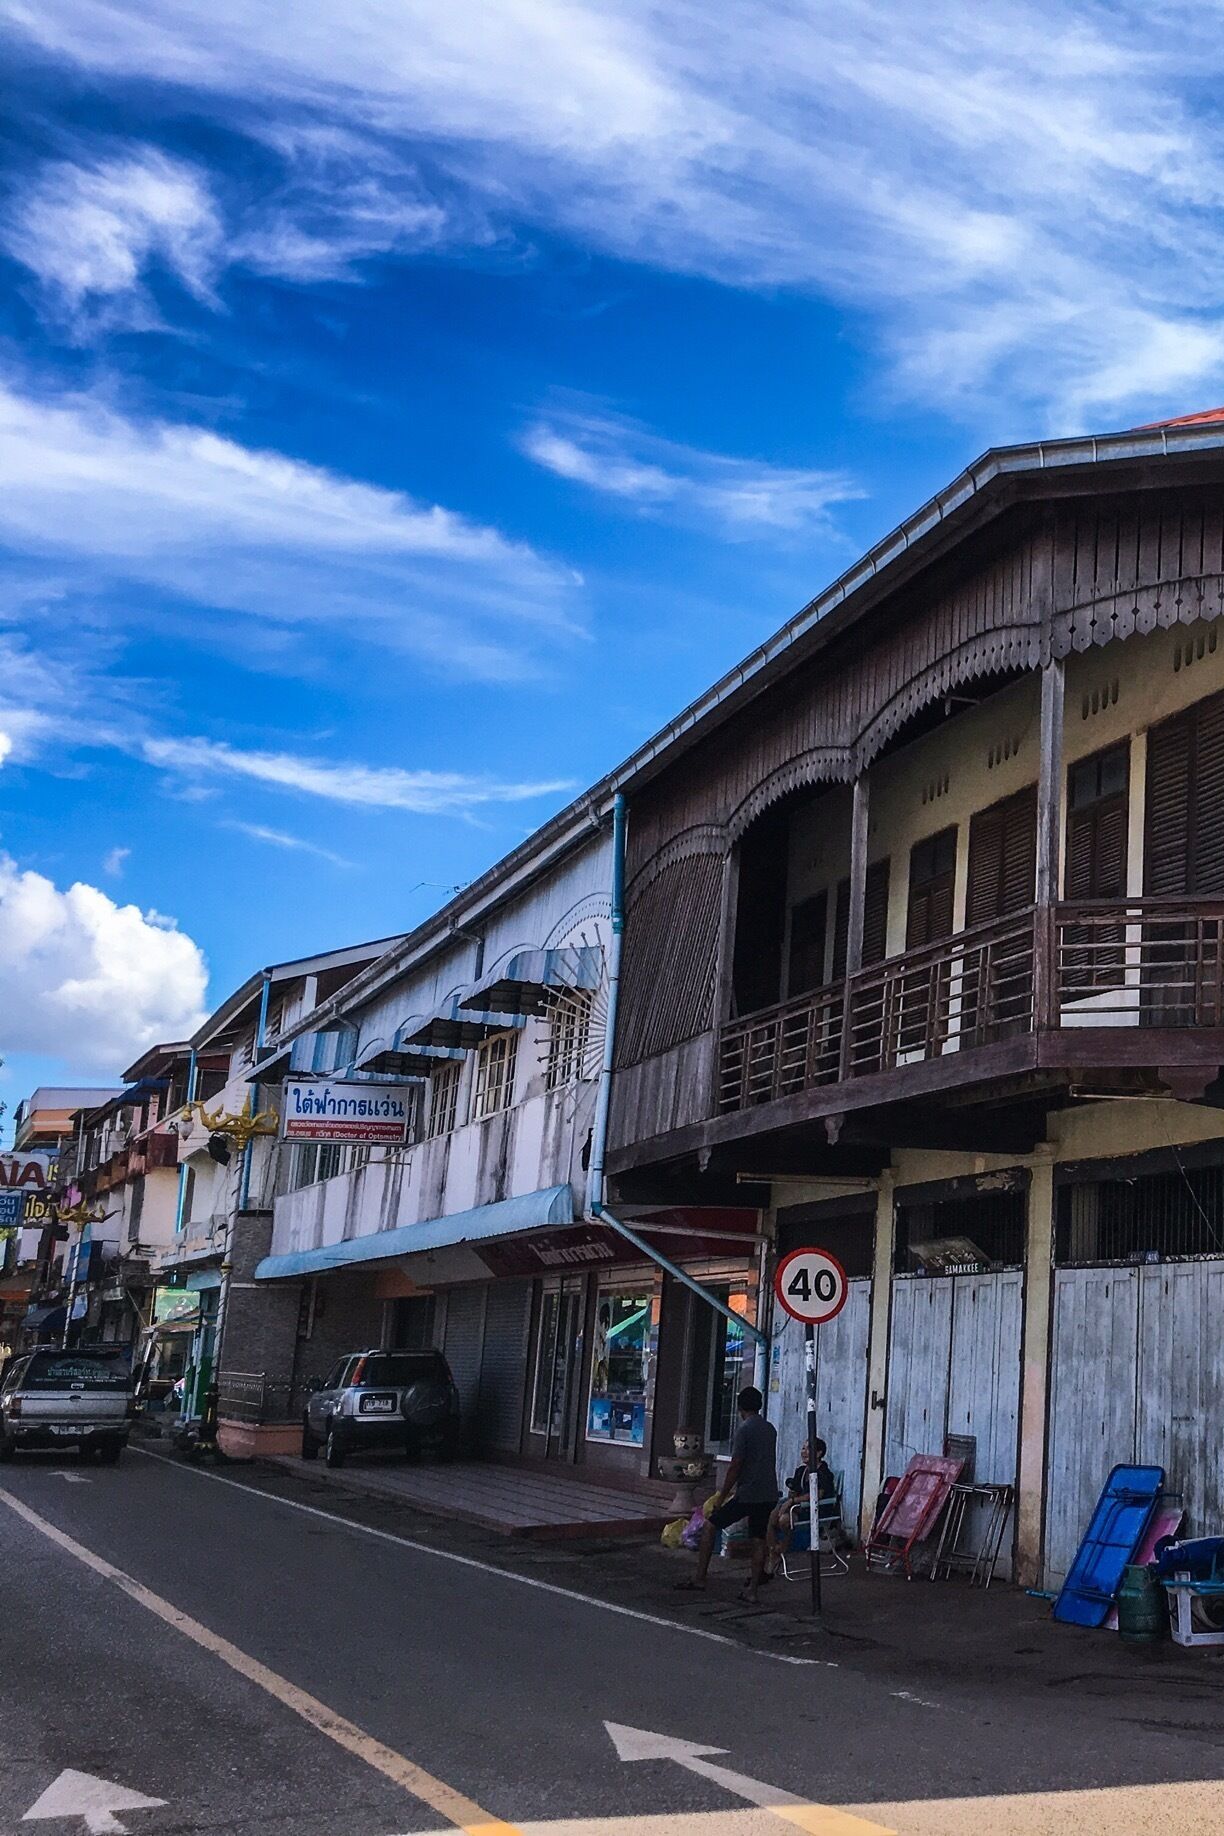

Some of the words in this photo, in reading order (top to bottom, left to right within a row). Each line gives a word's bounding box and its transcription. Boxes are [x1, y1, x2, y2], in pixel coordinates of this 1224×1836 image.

[293, 1088, 405, 1117] ใต้ฟ้าการแว่น
[944, 1263, 979, 1275] SAMAKKEE
[788, 1268, 837, 1302] 40
